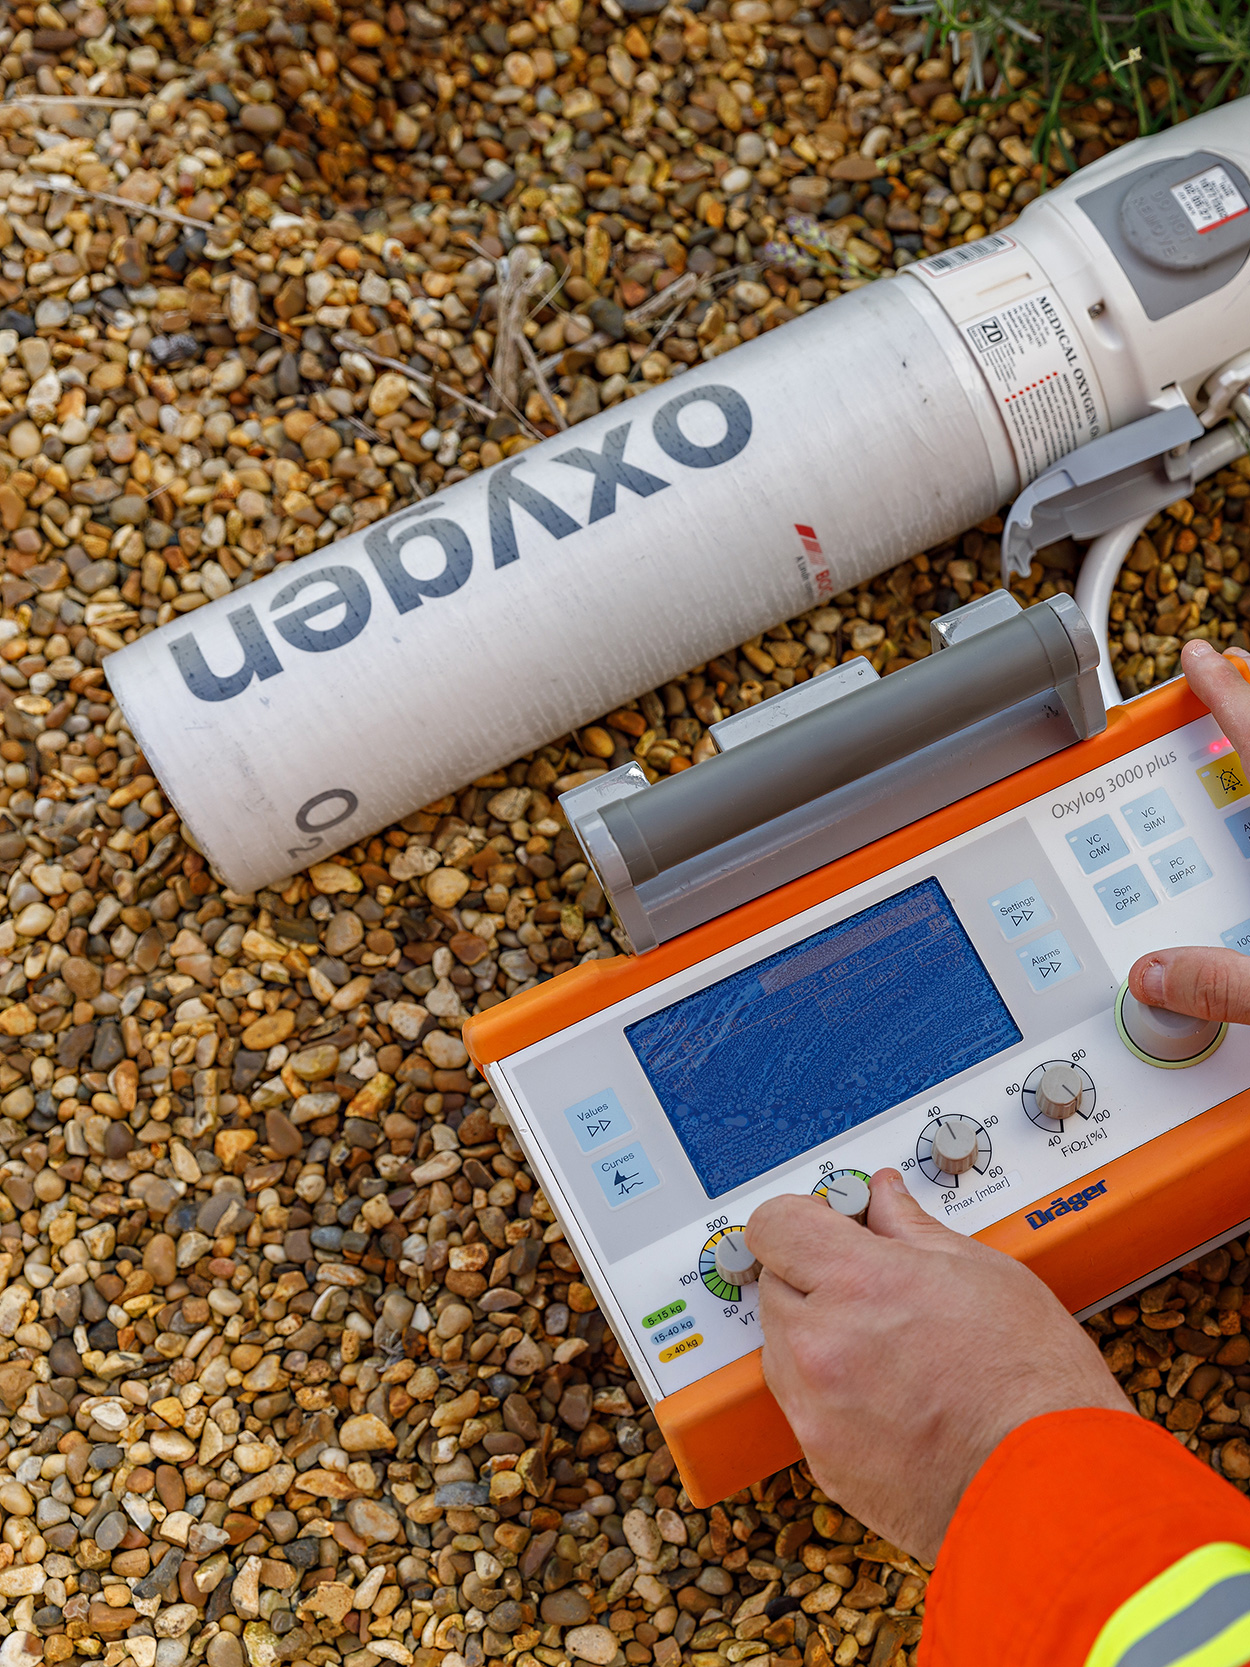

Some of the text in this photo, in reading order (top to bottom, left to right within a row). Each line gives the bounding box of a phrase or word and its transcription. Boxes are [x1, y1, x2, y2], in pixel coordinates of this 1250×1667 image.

[981, 320, 1003, 343] ZD
[1036, 295, 1078, 366] MEDICAL
[1073, 367, 1099, 426] OXYGEN
[166, 383, 753, 702] oxygen
[815, 569, 833, 598] BOC
[1050, 750, 1178, 820] Oxylog 3000 plus
[1141, 807, 1156, 819] VC
[1143, 815, 1167, 833] SIMV
[1086, 834, 1102, 846] VC
[1088, 843, 1111, 860] CMV
[1169, 857, 1185, 869] PC
[1168, 864, 1197, 885] BIPAP
[1112, 884, 1133, 898] Spn
[1000, 894, 1036, 918] Settings
[1114, 892, 1141, 912] CPAP
[1031, 946, 1061, 968] Alarms
[789, 979, 819, 999] FiO2
[822, 963, 849, 984] 100
[820, 988, 852, 1011] PEEP
[947, 936, 958, 948] 5
[681, 1034, 706, 1052] 8.5
[709, 1017, 744, 1040] L/min
[1071, 1049, 1086, 1062] 80
[1005, 1083, 1020, 1096] 60
[577, 1103, 609, 1122] Values
[927, 1105, 941, 1118] 40
[1092, 1109, 1111, 1124] 100
[984, 1114, 999, 1128] 50
[1048, 1135, 1062, 1148] 40
[1061, 1127, 1108, 1157] FiO2 [%]
[601, 1152, 635, 1172] Curves
[818, 1160, 834, 1174] 20
[901, 1157, 916, 1171] 30
[988, 1165, 1004, 1179] 60
[941, 1190, 956, 1204] 20
[945, 1176, 1011, 1216] Pmax [mbar]
[1025, 1179, 1107, 1230] Dräger
[706, 1215, 729, 1232] 500
[678, 1271, 699, 1287] 100
[647, 1303, 683, 1326] 5-15 kg
[723, 1304, 739, 1318] 50
[739, 1311, 755, 1326] VT
[654, 1319, 694, 1344] 15-40 kg
[674, 1343, 686, 1354] 40
[686, 1337, 699, 1350] kg
